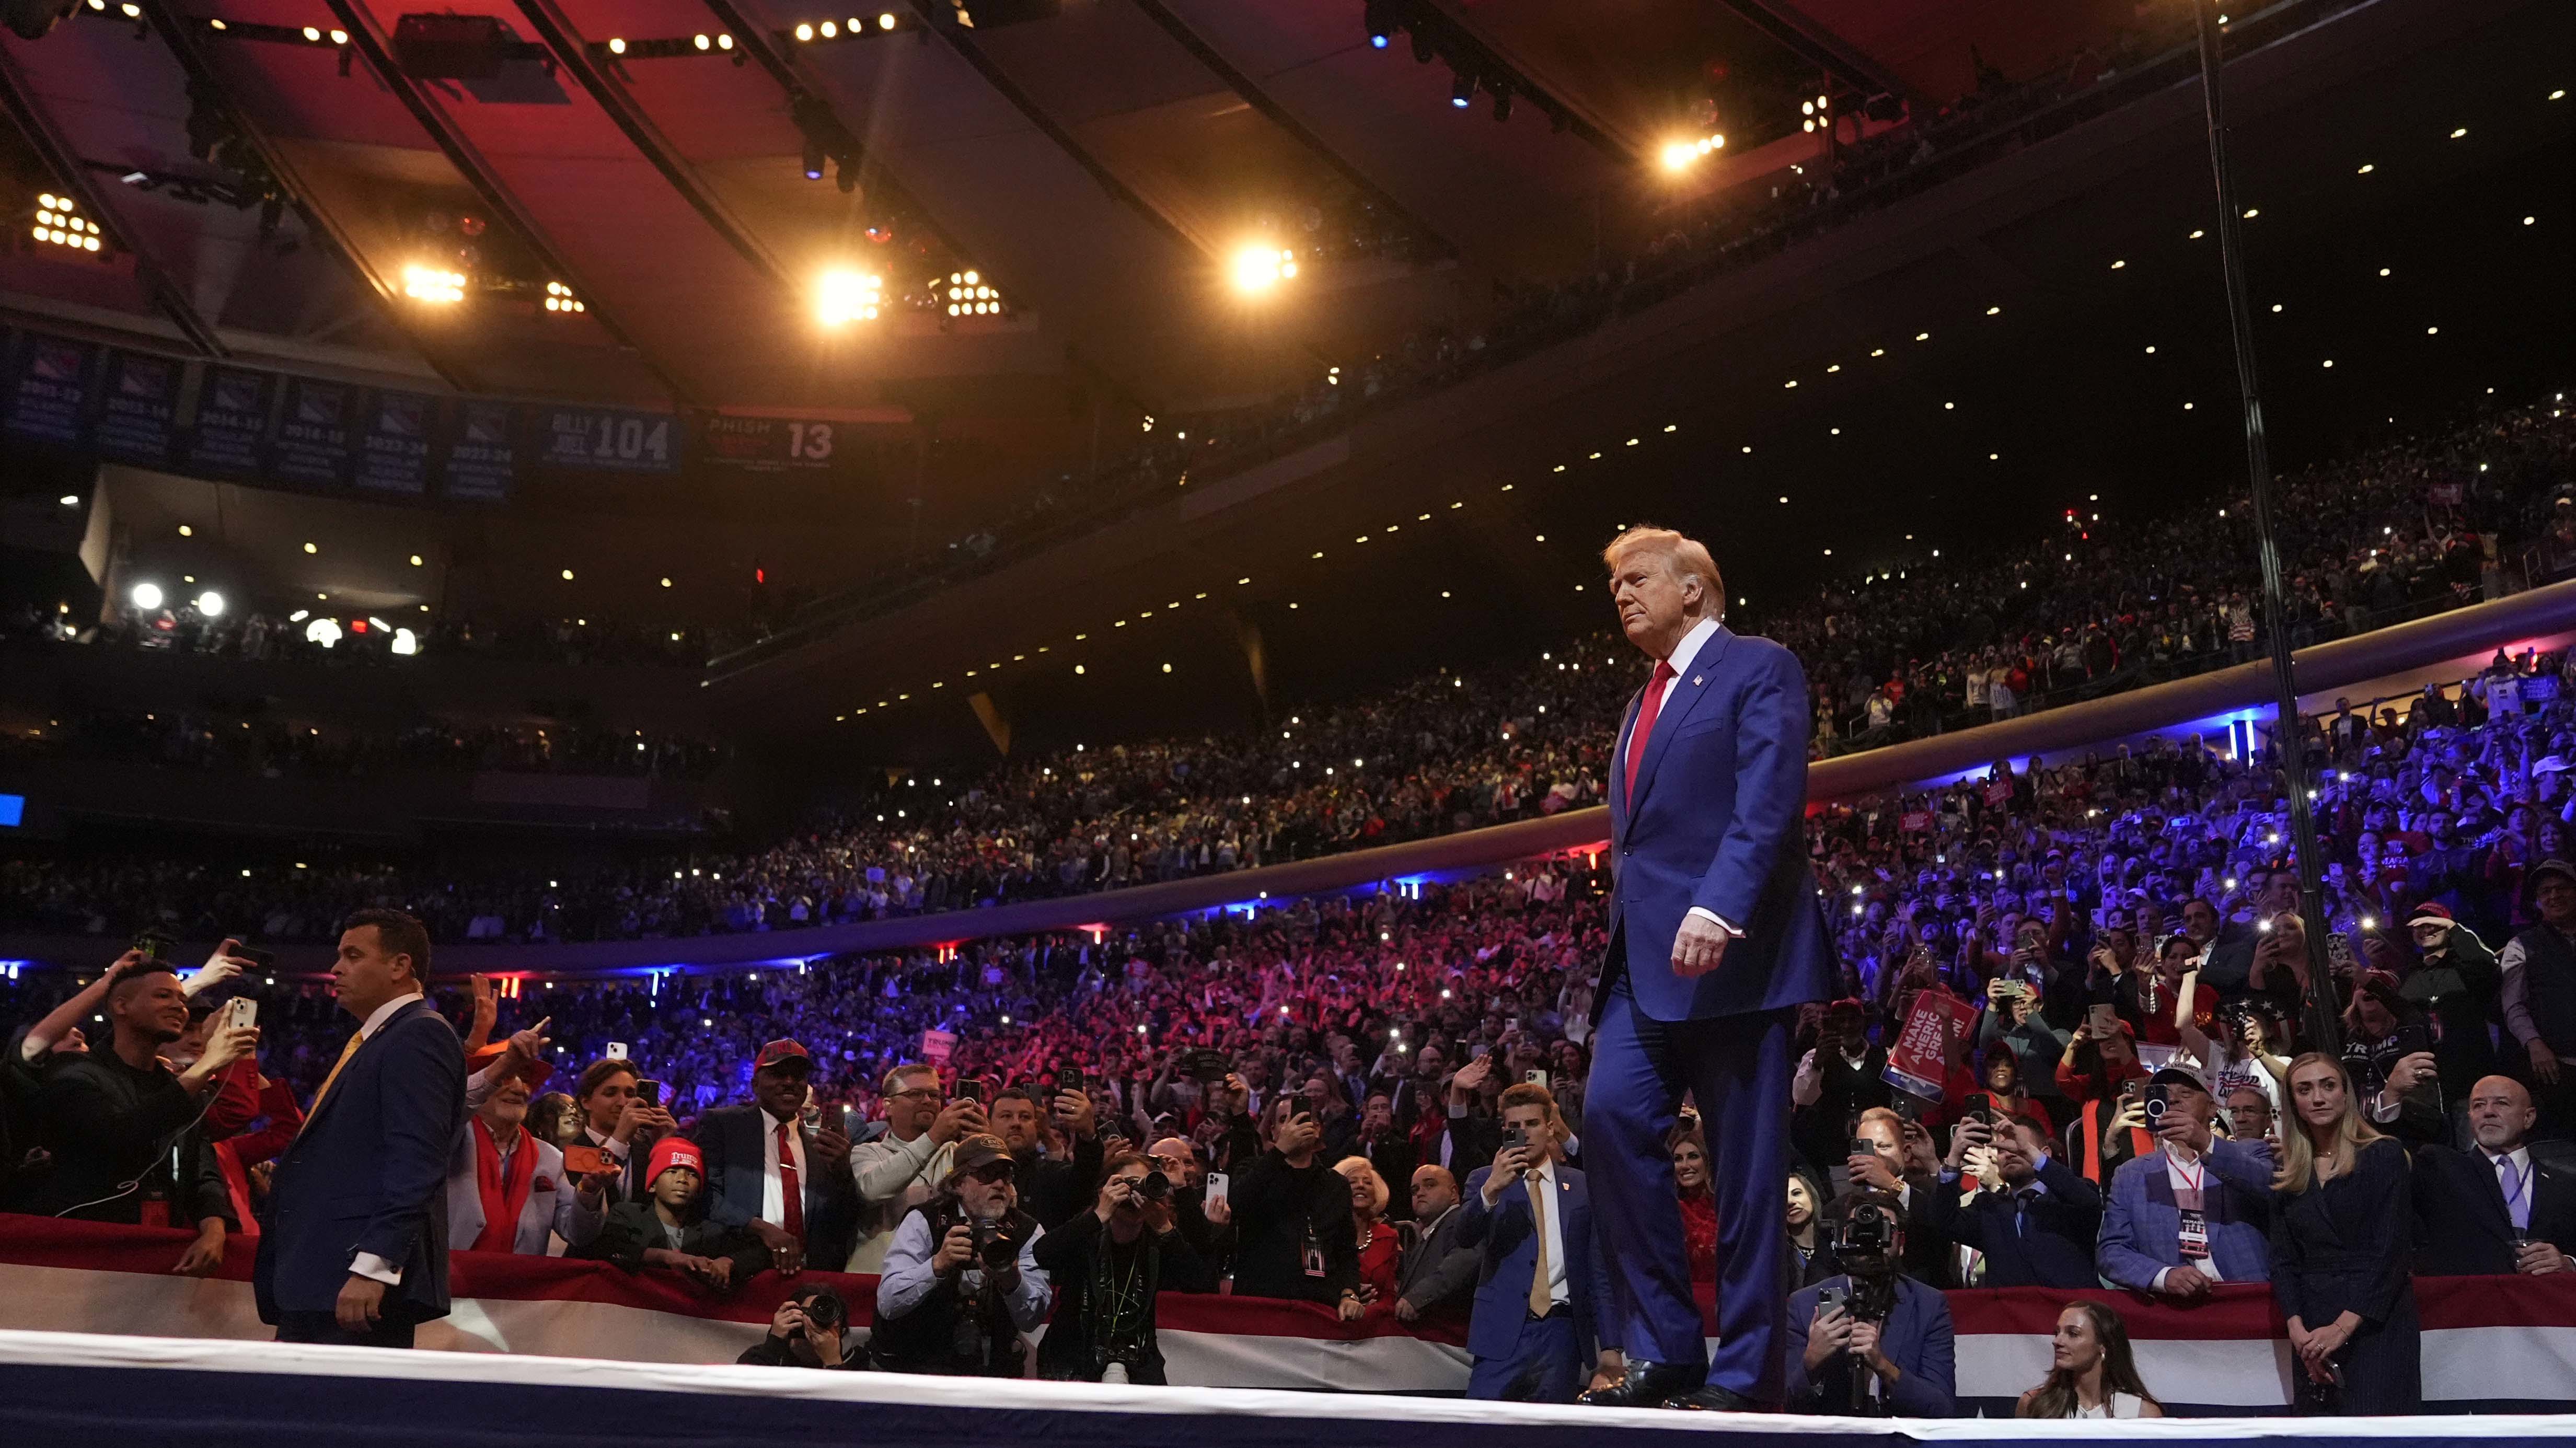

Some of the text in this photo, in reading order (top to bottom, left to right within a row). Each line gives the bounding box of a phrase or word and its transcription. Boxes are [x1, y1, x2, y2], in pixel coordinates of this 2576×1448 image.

[552, 414, 668, 460] BILLY 104
[709, 419, 771, 434] PHISH
[788, 423, 833, 459] 13
[1903, 1009, 1928, 1049] MAKE
[1910, 1012, 1940, 1065] AMERIC
[671, 1152, 698, 1163] Trump
